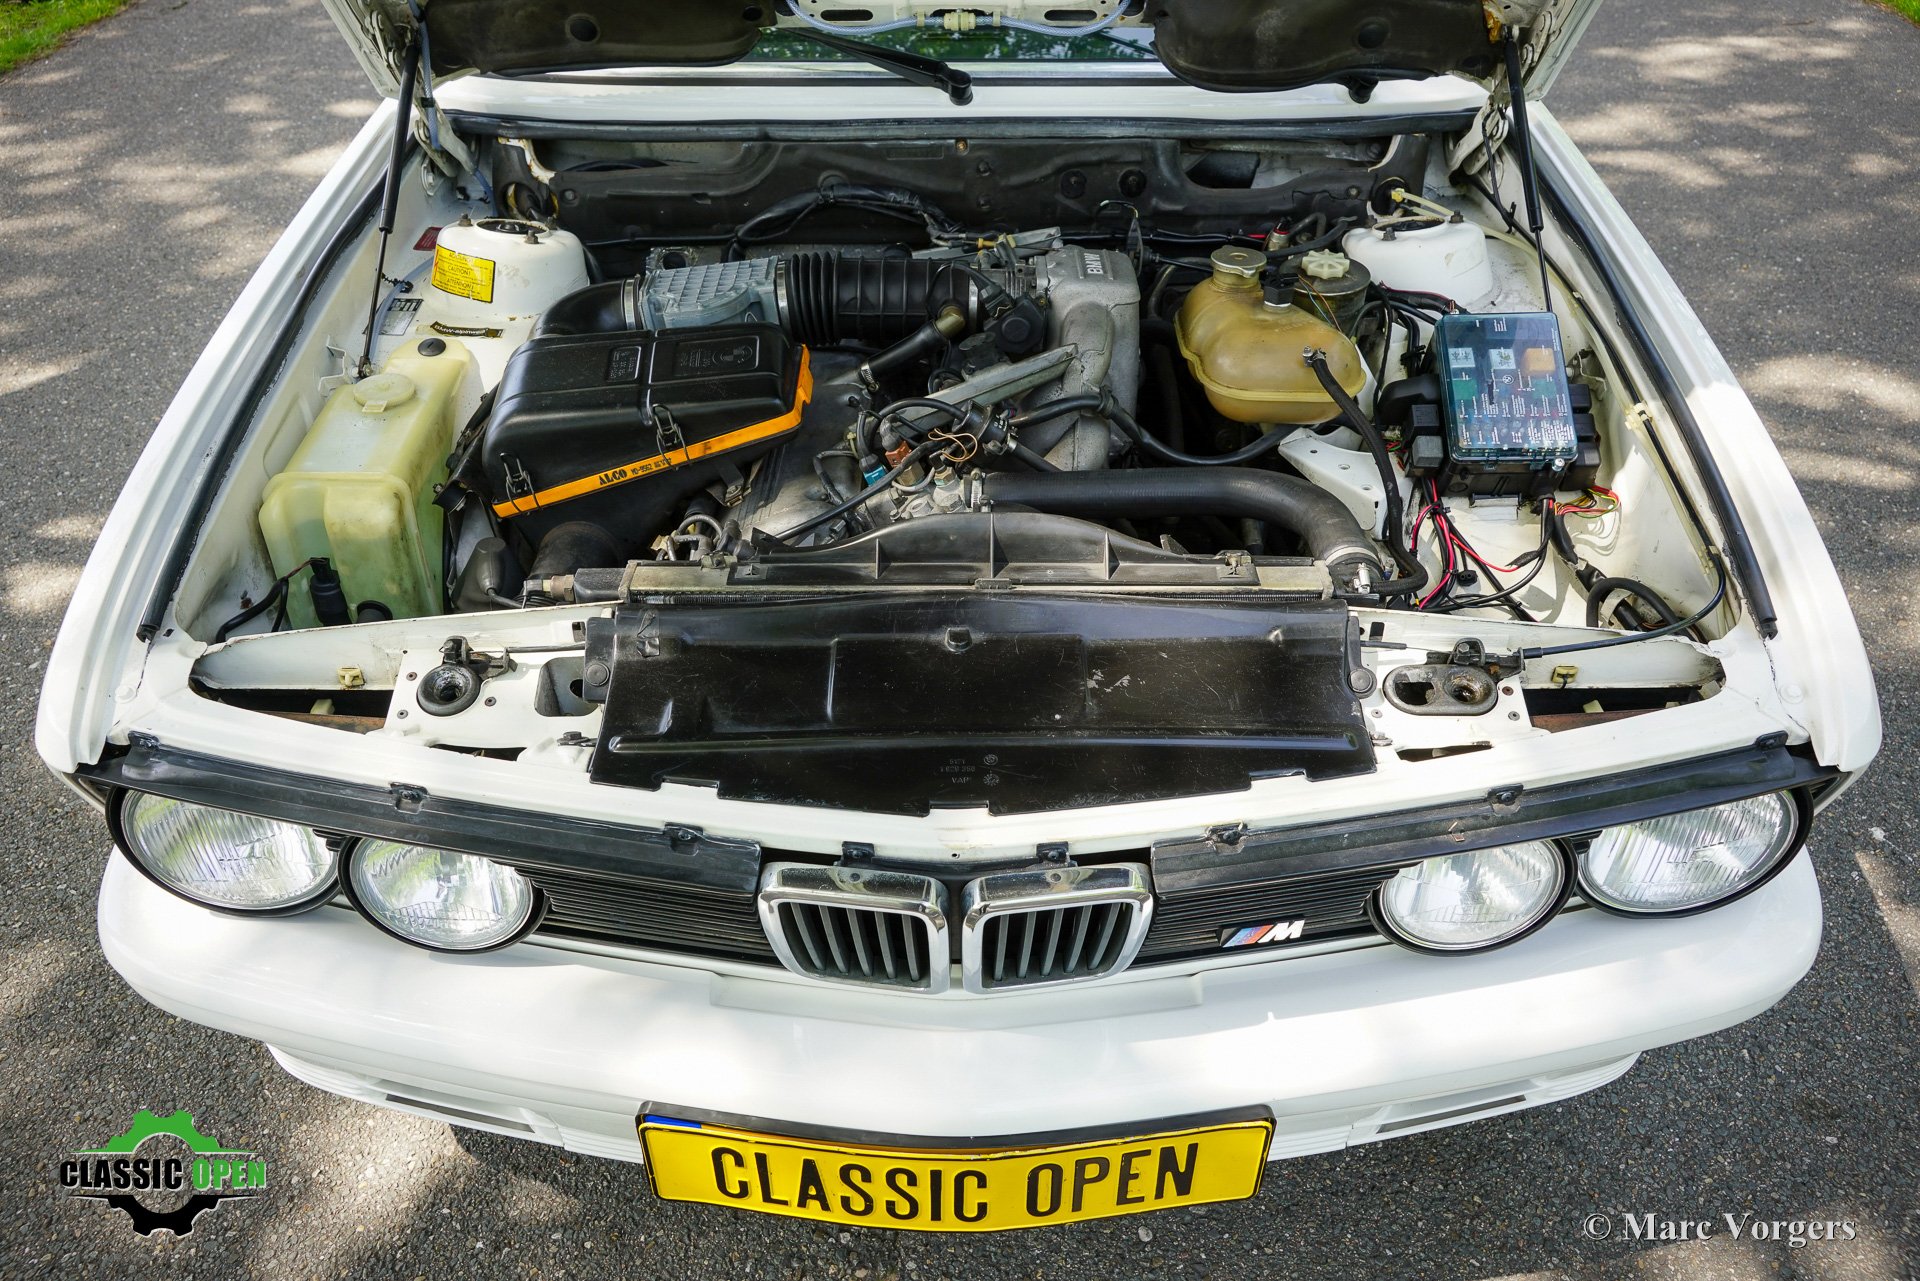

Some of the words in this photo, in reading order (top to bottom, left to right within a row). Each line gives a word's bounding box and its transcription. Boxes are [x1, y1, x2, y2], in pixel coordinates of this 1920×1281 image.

[1084, 253, 1103, 274] BMW
[598, 468, 628, 486] ALCO
[711, 1146, 988, 1223] CLASSIC
[1026, 1142, 1200, 1218] OPEN
